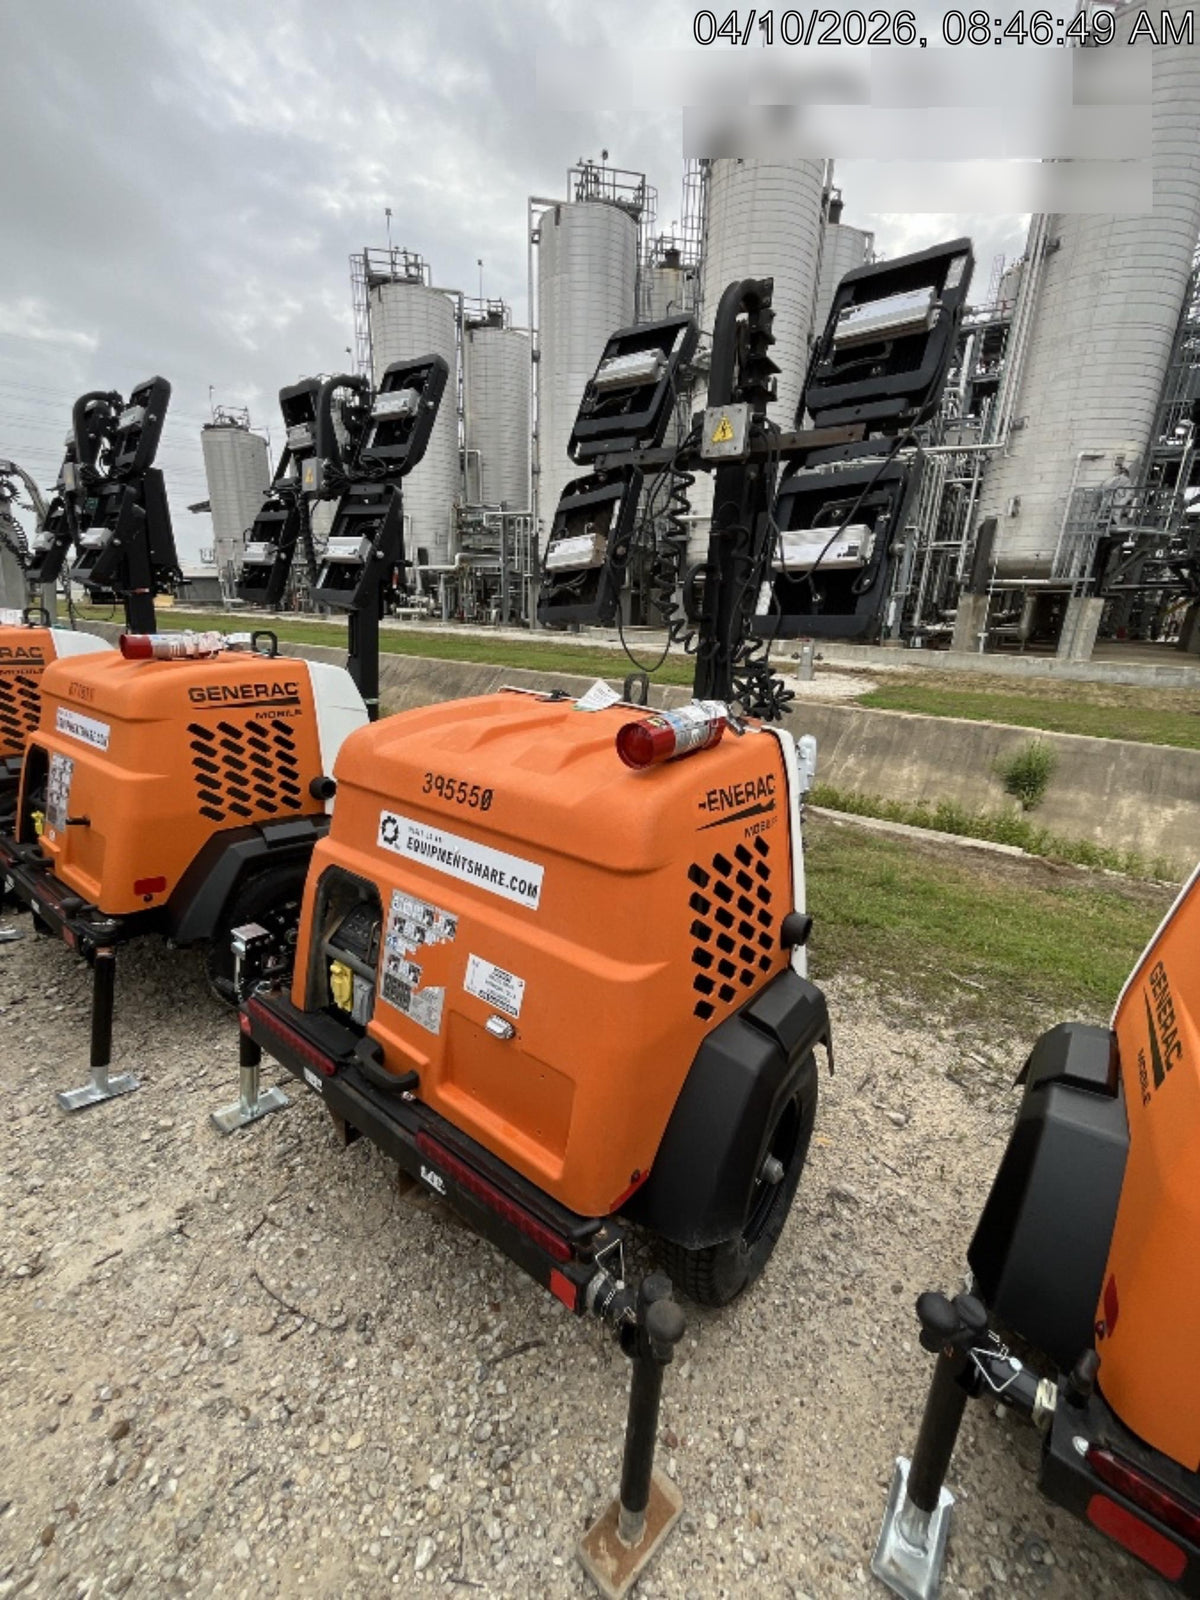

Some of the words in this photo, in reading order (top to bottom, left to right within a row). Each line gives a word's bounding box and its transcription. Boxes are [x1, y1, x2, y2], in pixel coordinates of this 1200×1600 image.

[188, 682, 298, 703] GENERAC
[422, 772, 494, 811] 395550
[406, 836, 538, 899] EQUIPMENTSHARE.COM
[1149, 960, 1182, 1072] GENERAC
